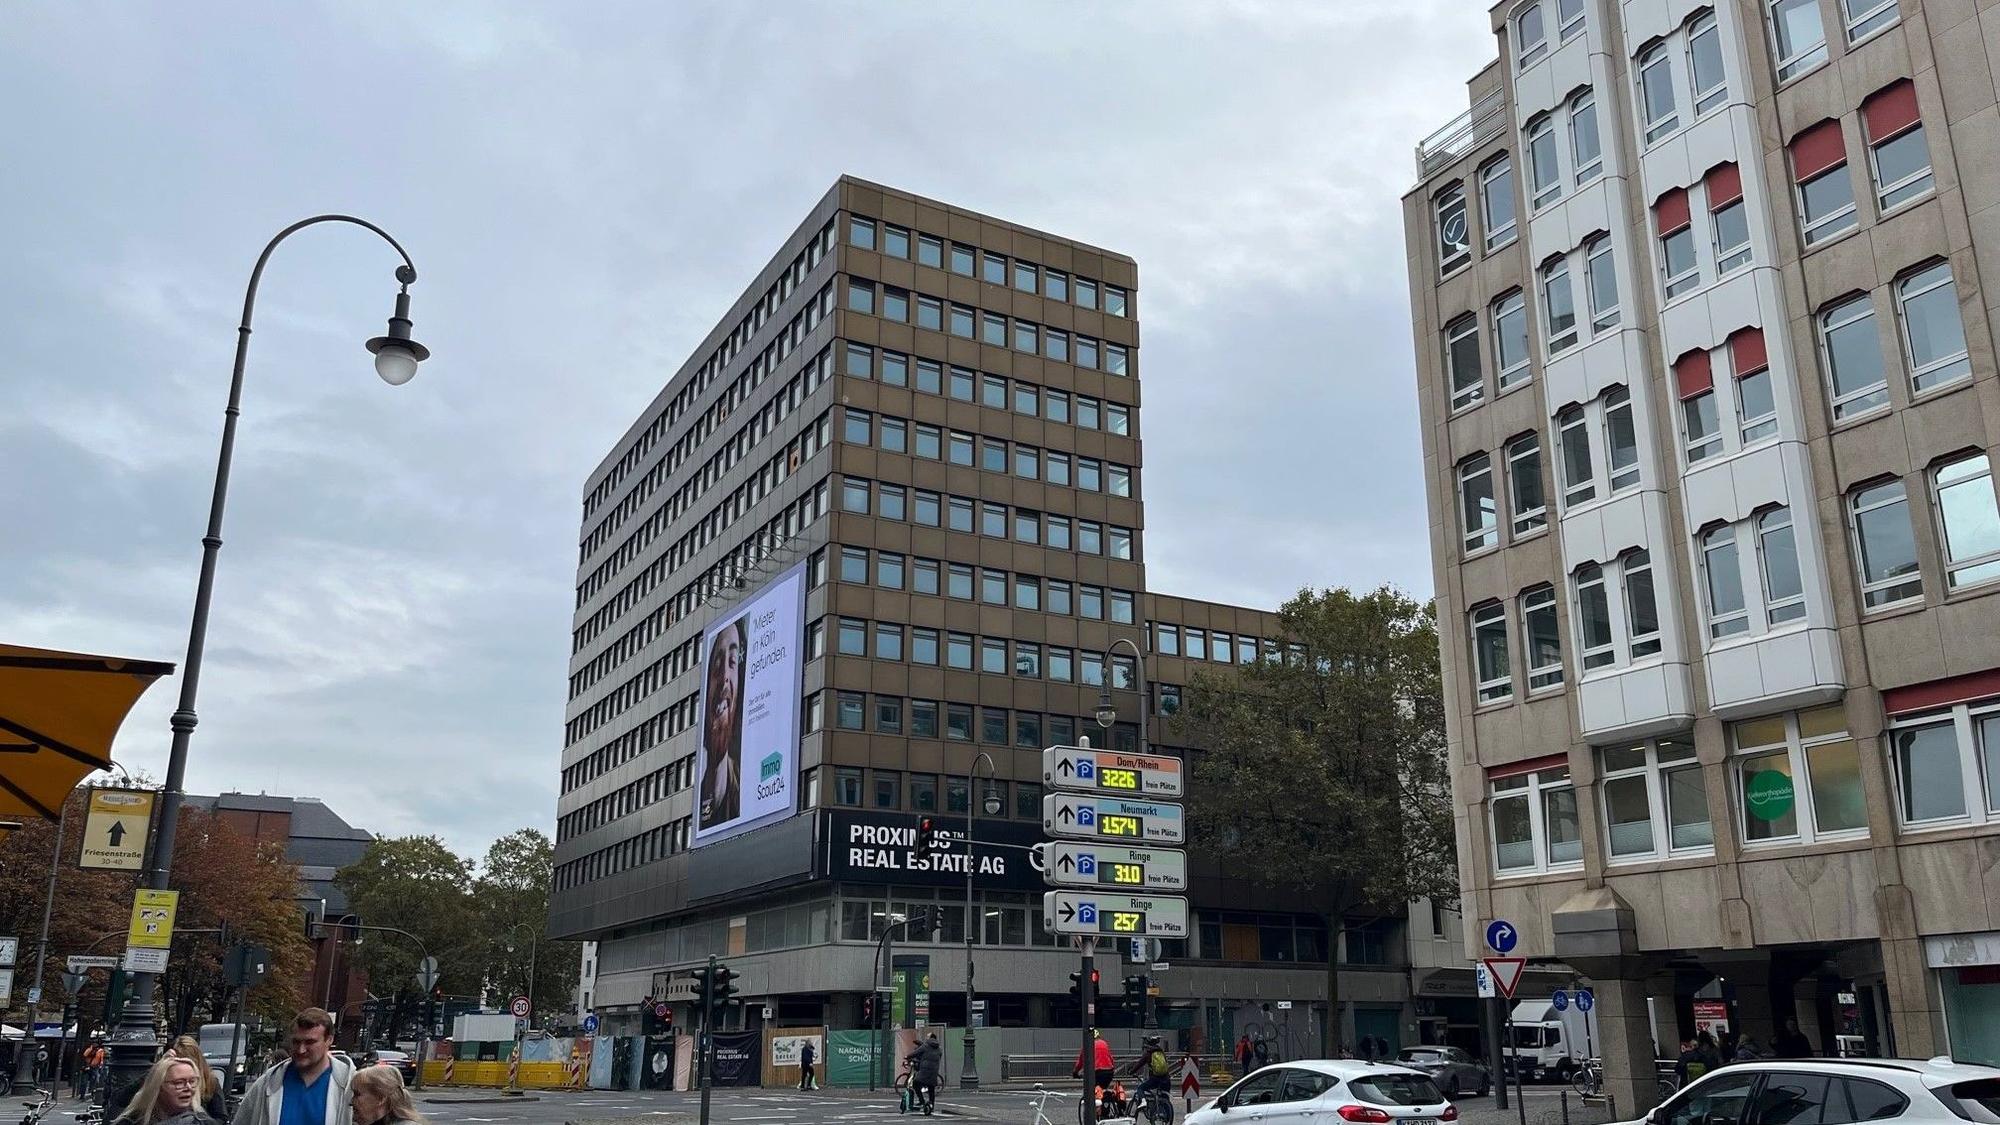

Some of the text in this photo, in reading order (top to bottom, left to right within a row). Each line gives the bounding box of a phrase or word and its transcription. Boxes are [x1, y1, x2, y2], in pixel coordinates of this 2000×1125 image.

[1117, 757, 1159, 769] Dom/Rhein
[1102, 769, 1136, 789] 3226
[1146, 780, 1177, 790] freie Plätze
[757, 777, 785, 800] Scout24
[1120, 804, 1158, 816] Neumarkt
[1102, 816, 1137, 836] 1574
[1147, 828, 1178, 837] freie Plätze
[85, 850, 142, 858] Friesenstraße
[1129, 851, 1151, 863] Ringe
[849, 850, 901, 869] REAL
[979, 859, 1005, 875] AG
[1114, 864, 1141, 883] 310
[1148, 875, 1180, 884] freie Plätze
[1130, 899, 1153, 911] Ringe
[1113, 912, 1140, 931] 257
[1149, 923, 1181, 931] freie Plätze
[515, 1002, 527, 1012] 30
